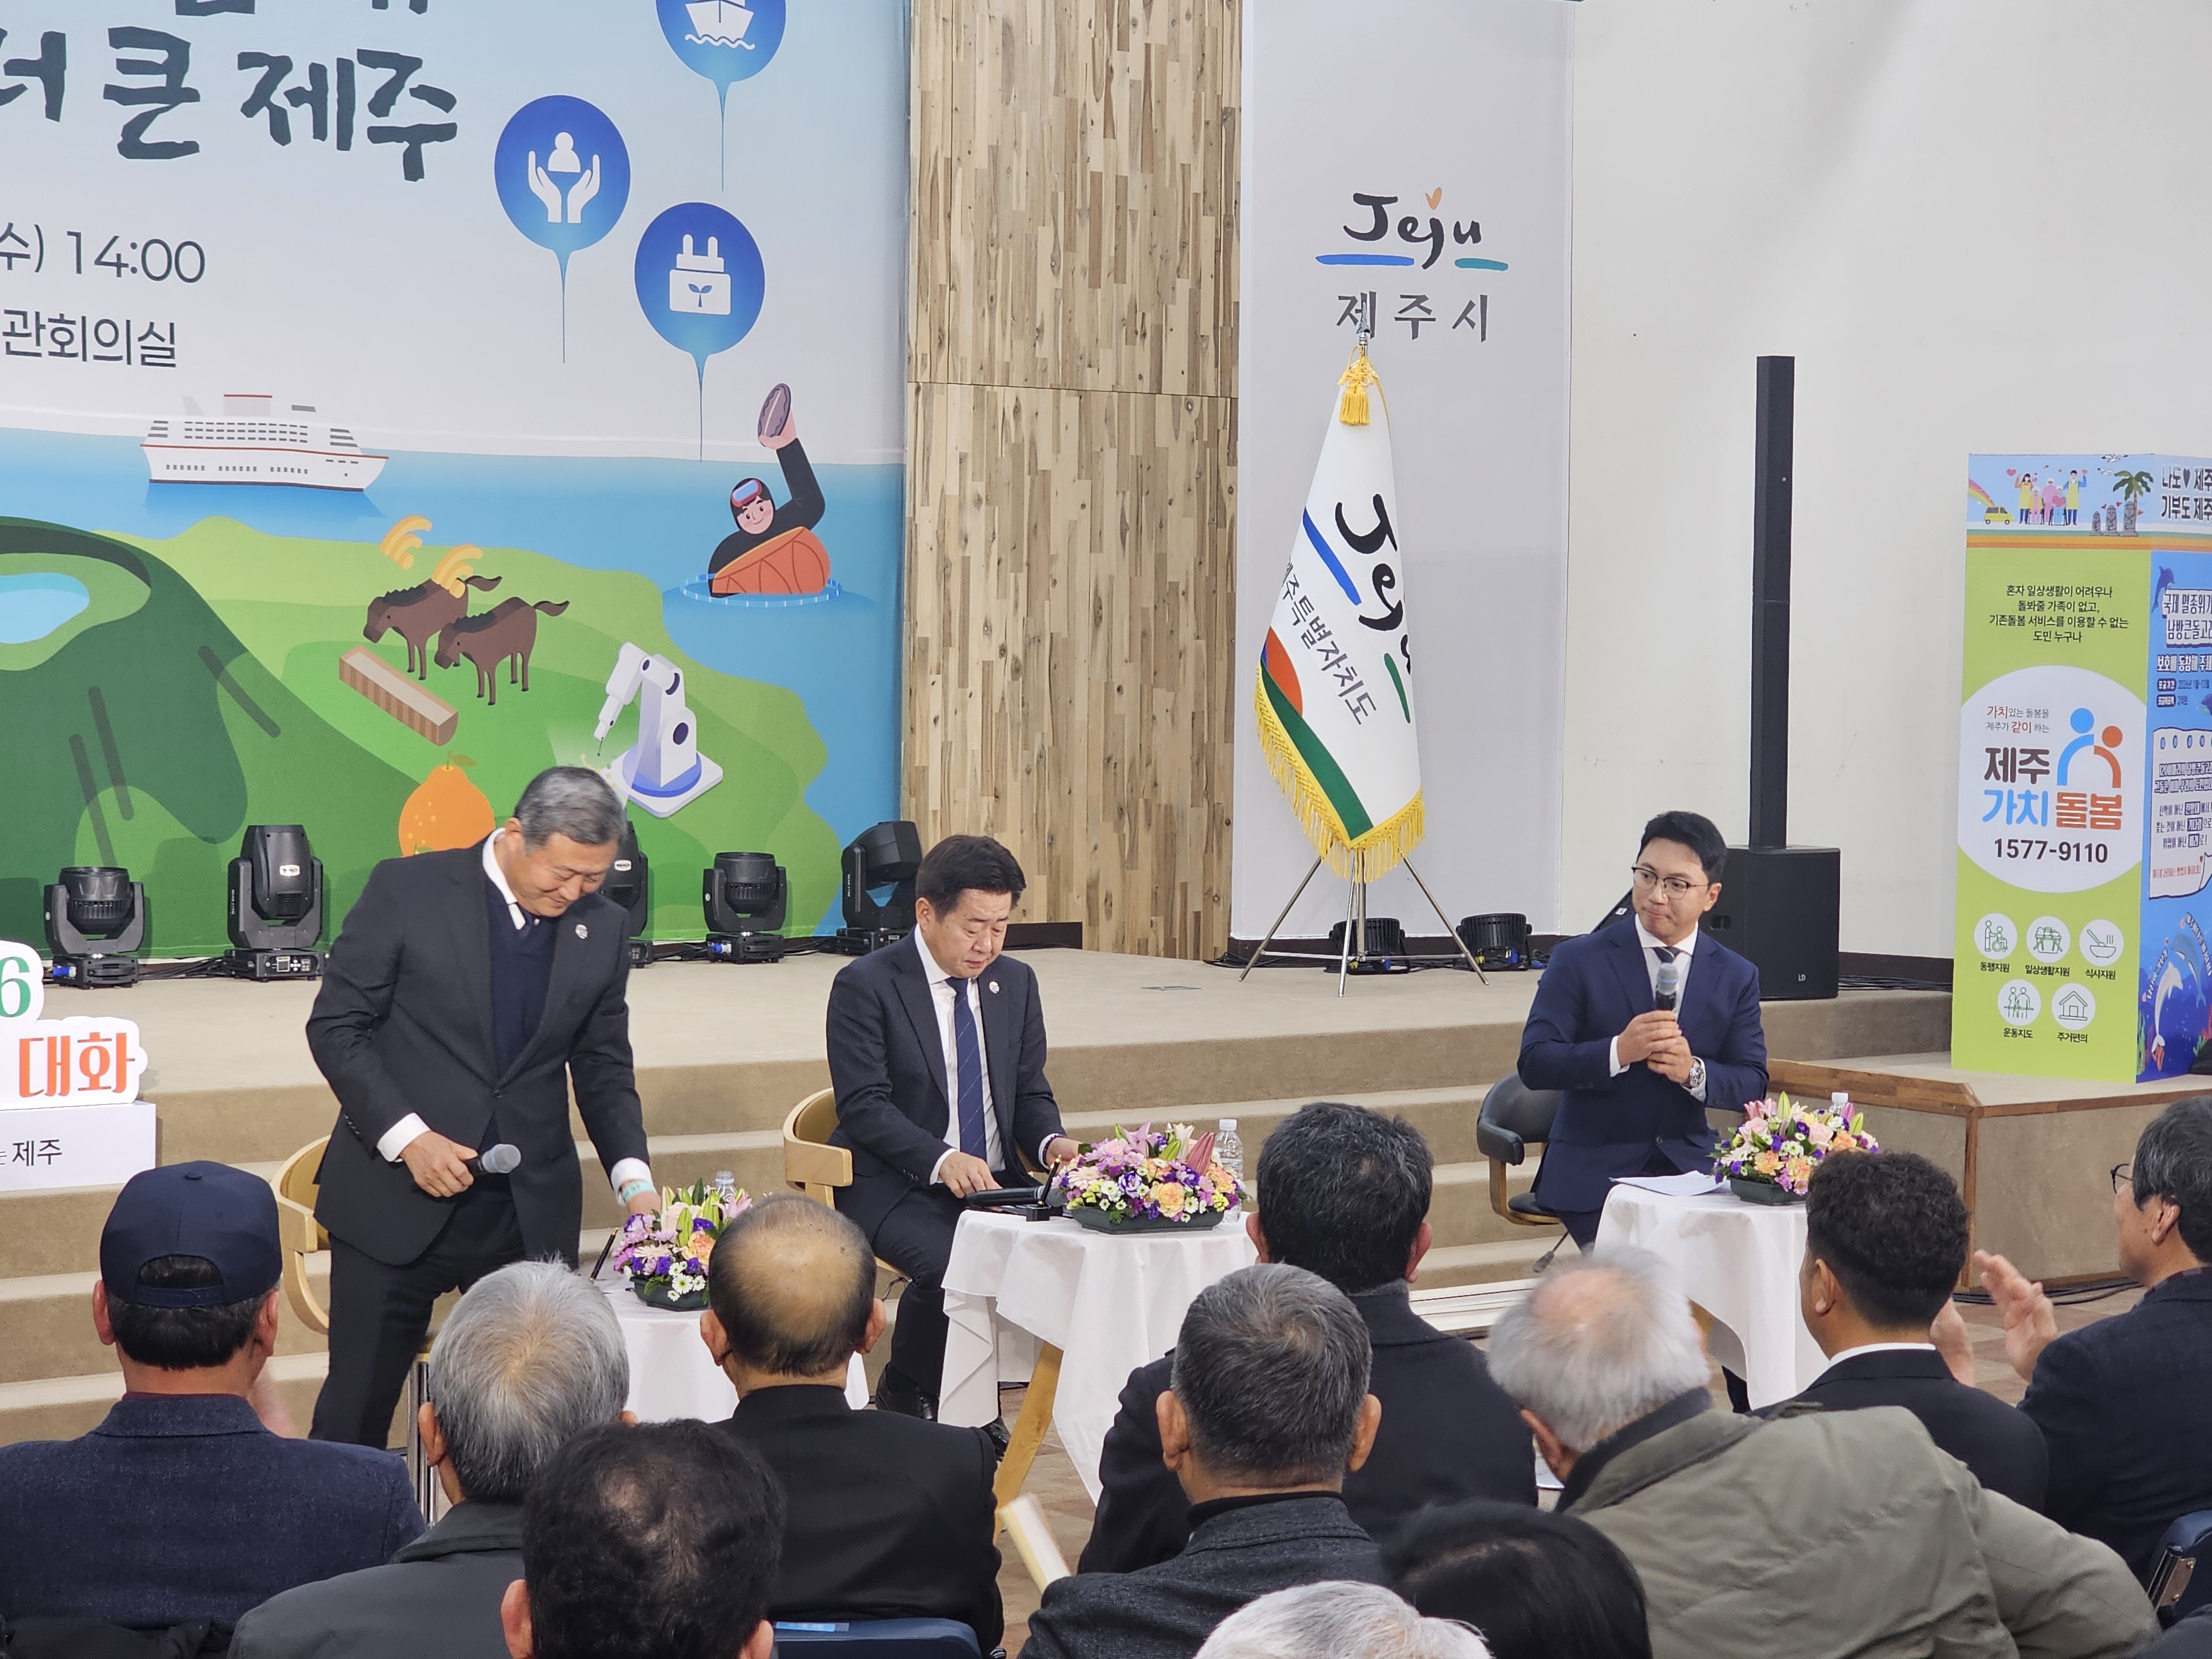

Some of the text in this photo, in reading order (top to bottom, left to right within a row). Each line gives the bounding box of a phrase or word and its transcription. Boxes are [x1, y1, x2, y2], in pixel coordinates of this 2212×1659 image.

[103, 26, 201, 159] 큰
[237, 48, 458, 182] 제주
[1343, 187, 1481, 269] Jeju
[66, 231, 206, 283] 14:00
[1336, 291, 1488, 342] 제주시
[3, 310, 177, 367] 관회의실
[2193, 467, 2212, 492] 제주
[2161, 495, 2212, 521] 기부도 제주
[2006, 585, 2112, 598] 혼자 일상생활이 어려우나
[2163, 593, 2179, 614] 국제
[2018, 600, 2100, 613] 돌봐줄 가족이 없고,
[1990, 614, 2128, 629] 기존돌봄 서비스를 이용할 수 없는
[2033, 631, 2082, 643] 도민 누구나
[1987, 706, 2050, 718] 가치있는 돌봄을
[1986, 721, 2049, 733] 제주가 같이 하는
[1984, 747, 2050, 784] 제주
[1983, 789, 2122, 830] 가치돌봄
[1995, 838, 2108, 863] 1577-9110
[1980, 962, 2010, 973] 동행지원
[2025, 965, 2070, 977] 일상생활지원
[2085, 969, 2116, 980] 식사지원
[0, 956, 32, 1018] 6
[2003, 1028, 2033, 1039] 운동지도
[2057, 1032, 2088, 1044] 주거편의
[19, 1032, 135, 1098] 대화
[12, 1139, 62, 1166] 제주
